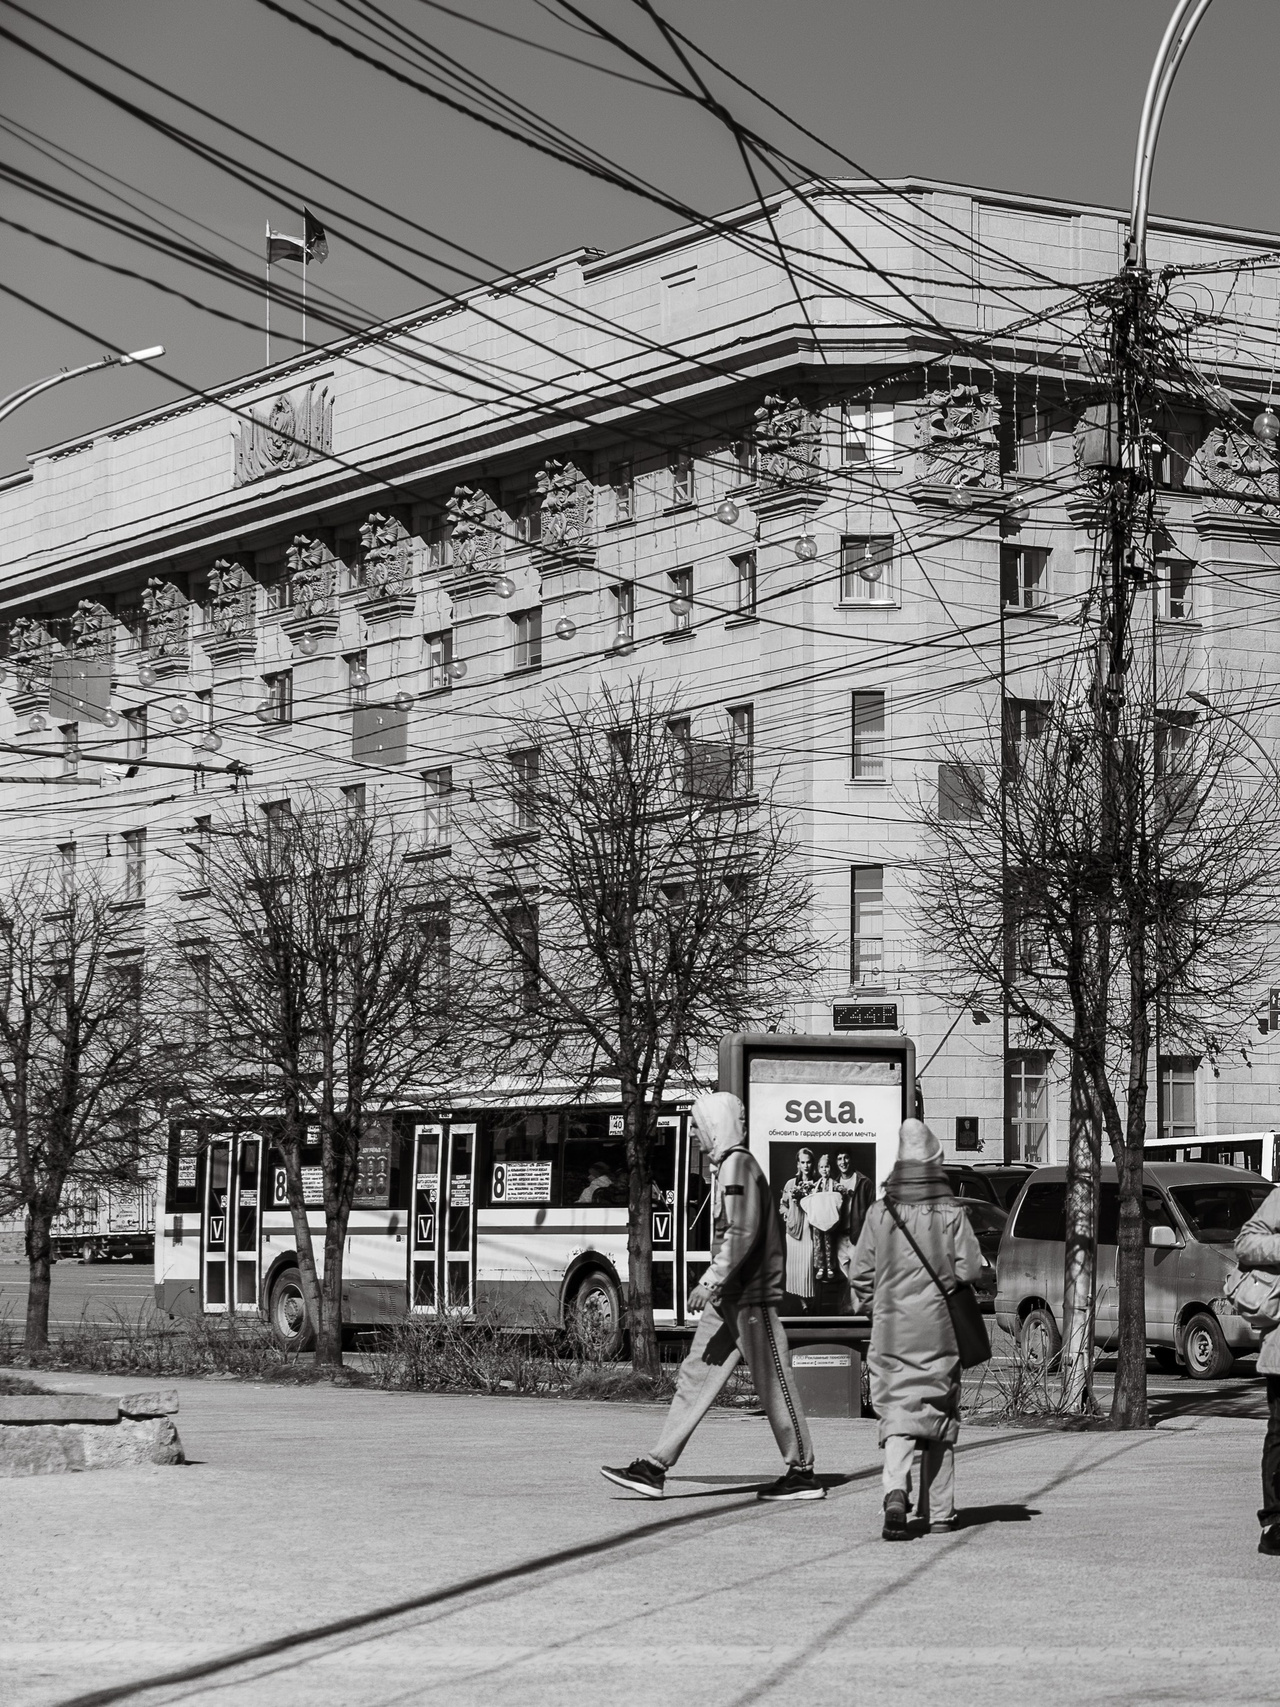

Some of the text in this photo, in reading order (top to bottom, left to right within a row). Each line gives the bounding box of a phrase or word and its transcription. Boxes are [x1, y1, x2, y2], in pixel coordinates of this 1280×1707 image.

[613, 1120, 623, 1129] 40
[784, 1099, 865, 1125] sela.
[768, 1128, 799, 1137] обновить
[799, 1129, 832, 1138] гардероб
[275, 1170, 287, 1202] 8
[493, 1165, 506, 1199] 8
